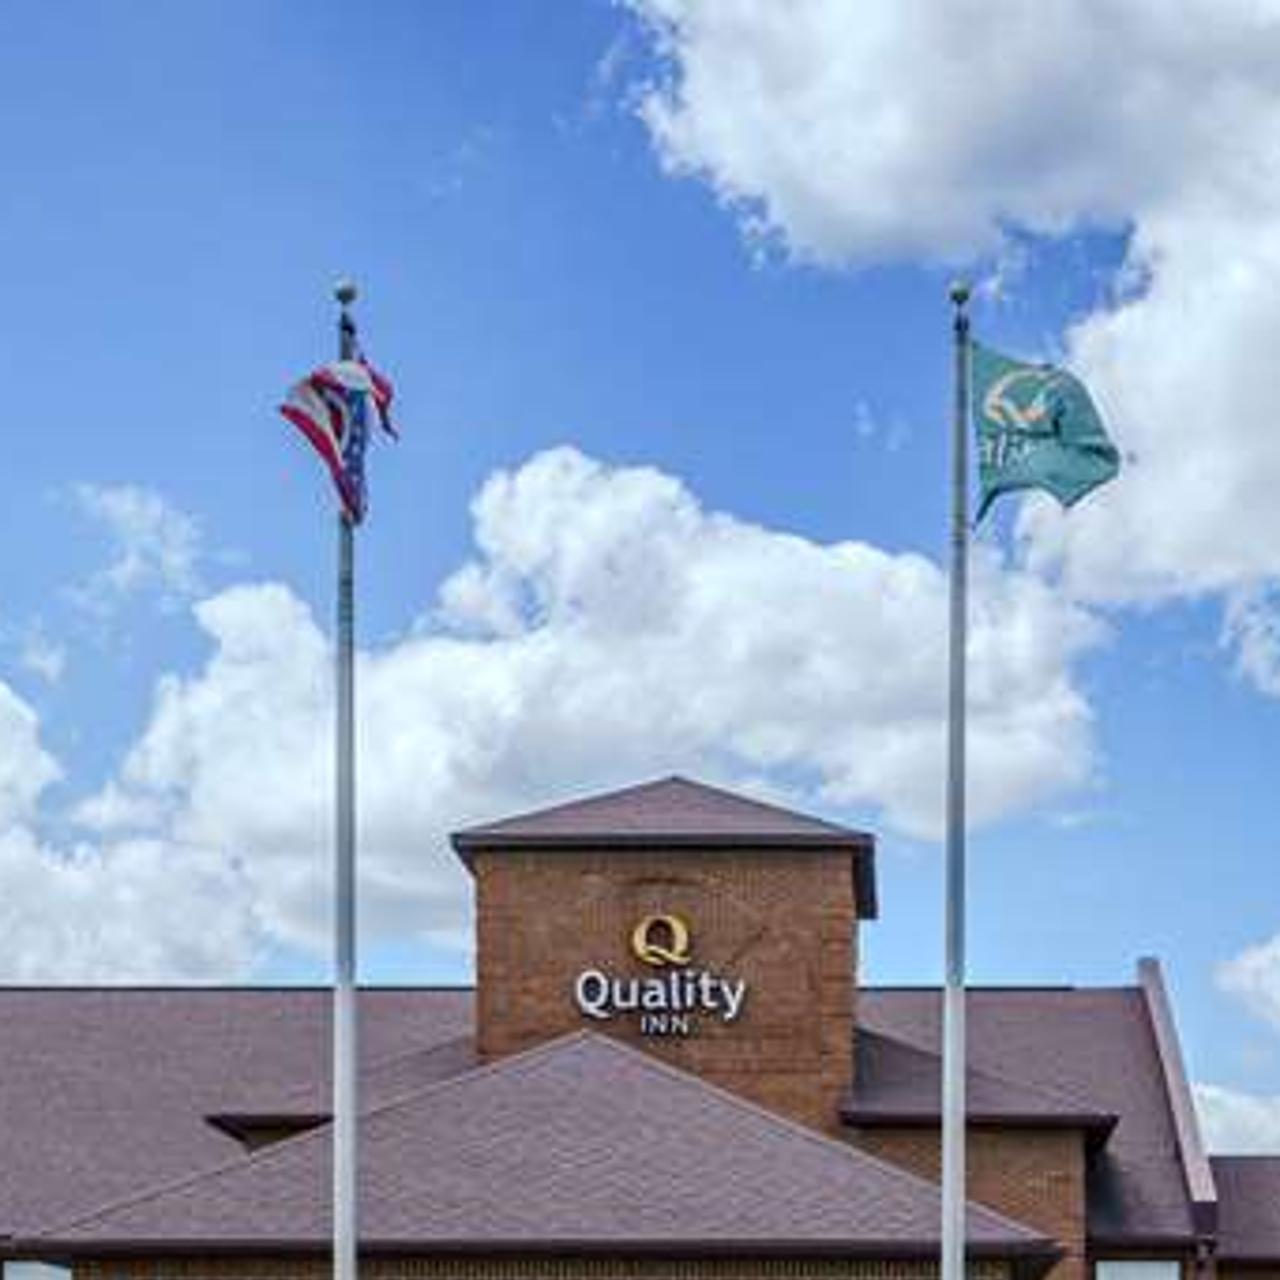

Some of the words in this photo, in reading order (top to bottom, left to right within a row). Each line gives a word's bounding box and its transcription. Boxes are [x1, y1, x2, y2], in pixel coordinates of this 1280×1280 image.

[632, 914, 691, 965] Q
[575, 968, 746, 1020] Quality
[640, 1015, 690, 1034] INN
